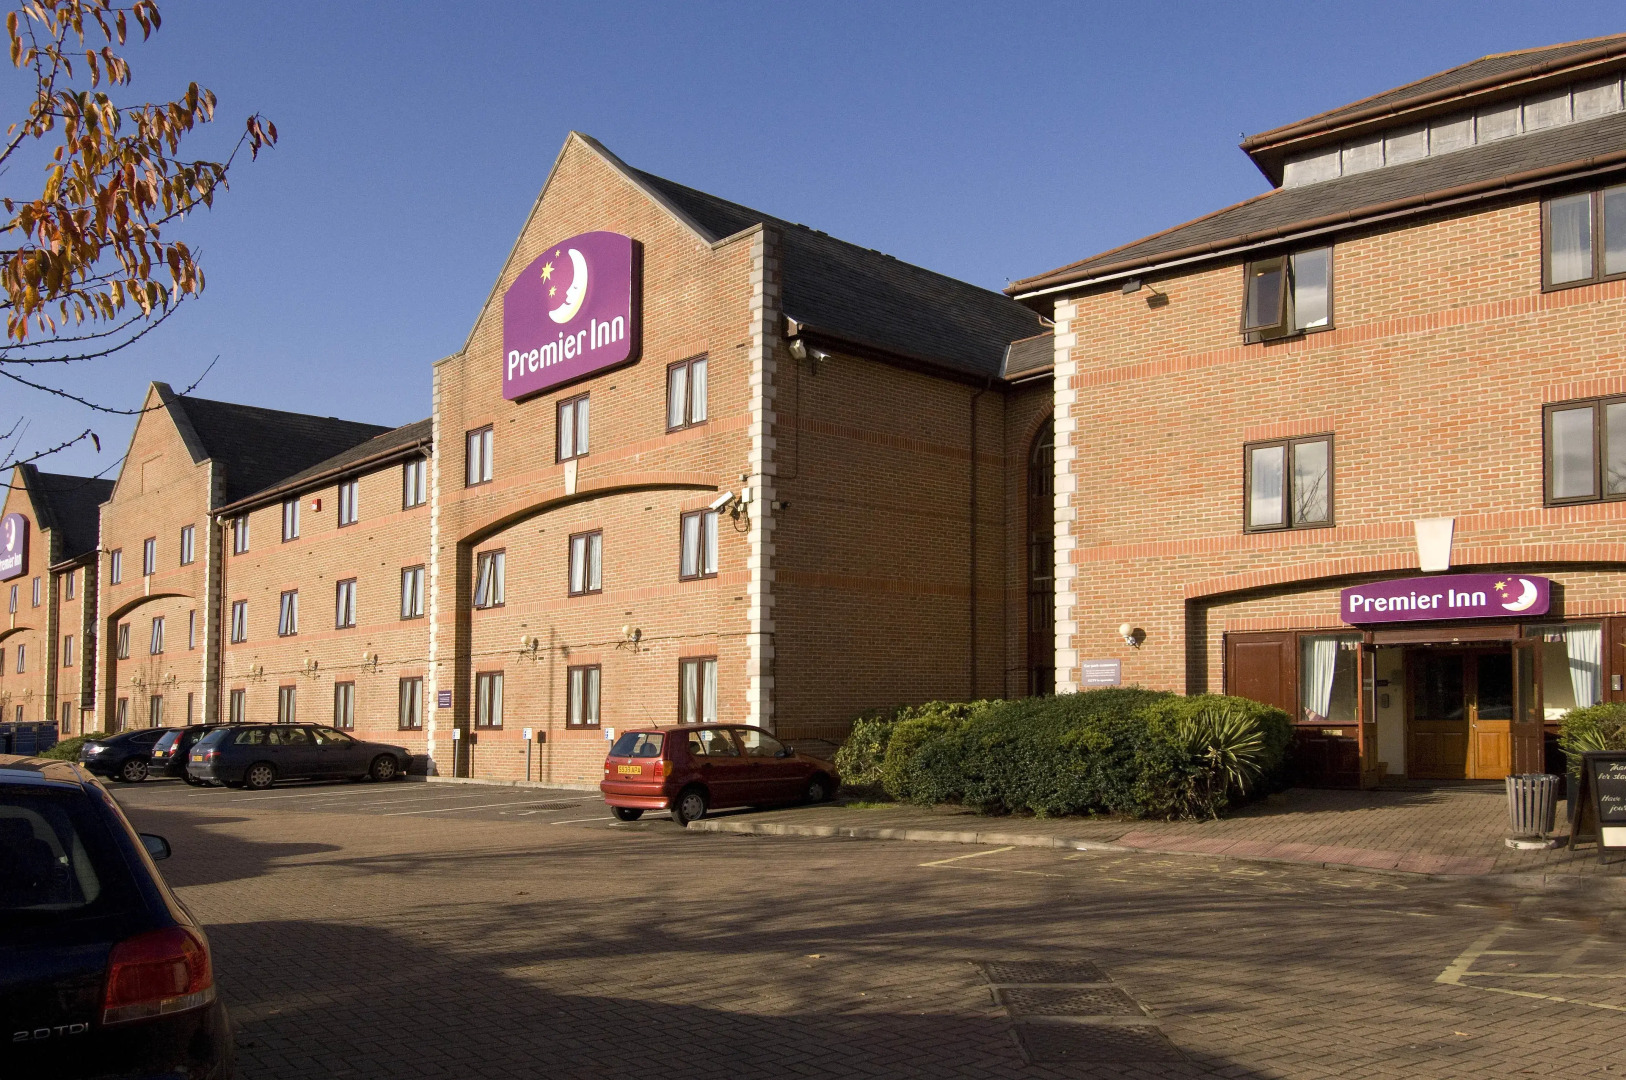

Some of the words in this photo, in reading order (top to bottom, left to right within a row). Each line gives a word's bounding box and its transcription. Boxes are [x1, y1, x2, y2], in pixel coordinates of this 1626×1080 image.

[508, 330, 587, 381] Premier
[590, 315, 624, 350] Inn
[1349, 591, 1443, 613] Premier
[1448, 588, 1487, 608] Inn
[1601, 794, 1621, 802] Have
[12, 1027, 51, 1042] 2.0
[53, 1022, 89, 1036] TDI
